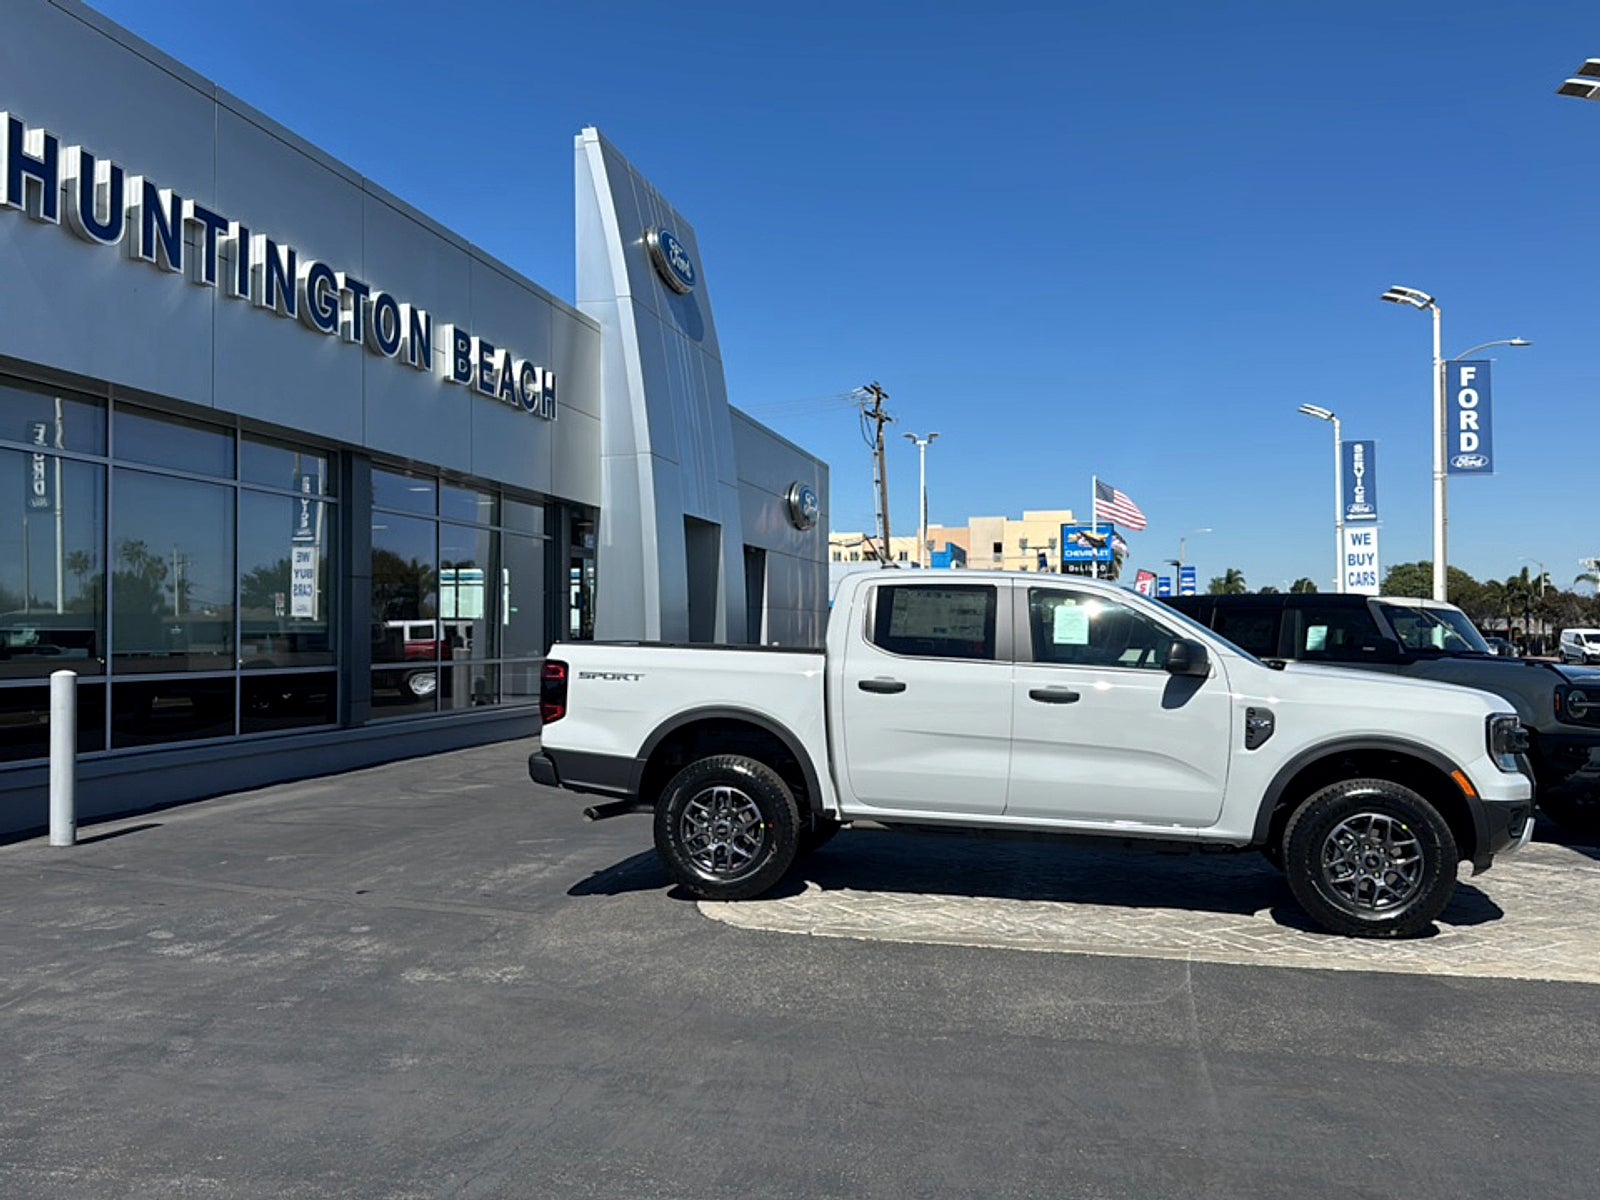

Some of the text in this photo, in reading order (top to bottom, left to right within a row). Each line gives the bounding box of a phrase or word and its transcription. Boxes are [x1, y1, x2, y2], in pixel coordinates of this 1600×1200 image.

[0, 111, 558, 421] HUNTINGTON BEACH
[668, 238, 692, 279] Ford
[1458, 367, 1480, 452] FORD
[1353, 444, 1365, 503] SERVICE
[1351, 533, 1371, 545] WE
[1348, 554, 1374, 566] BUY
[1348, 572, 1376, 586] CARS
[579, 671, 645, 681] SPORT
